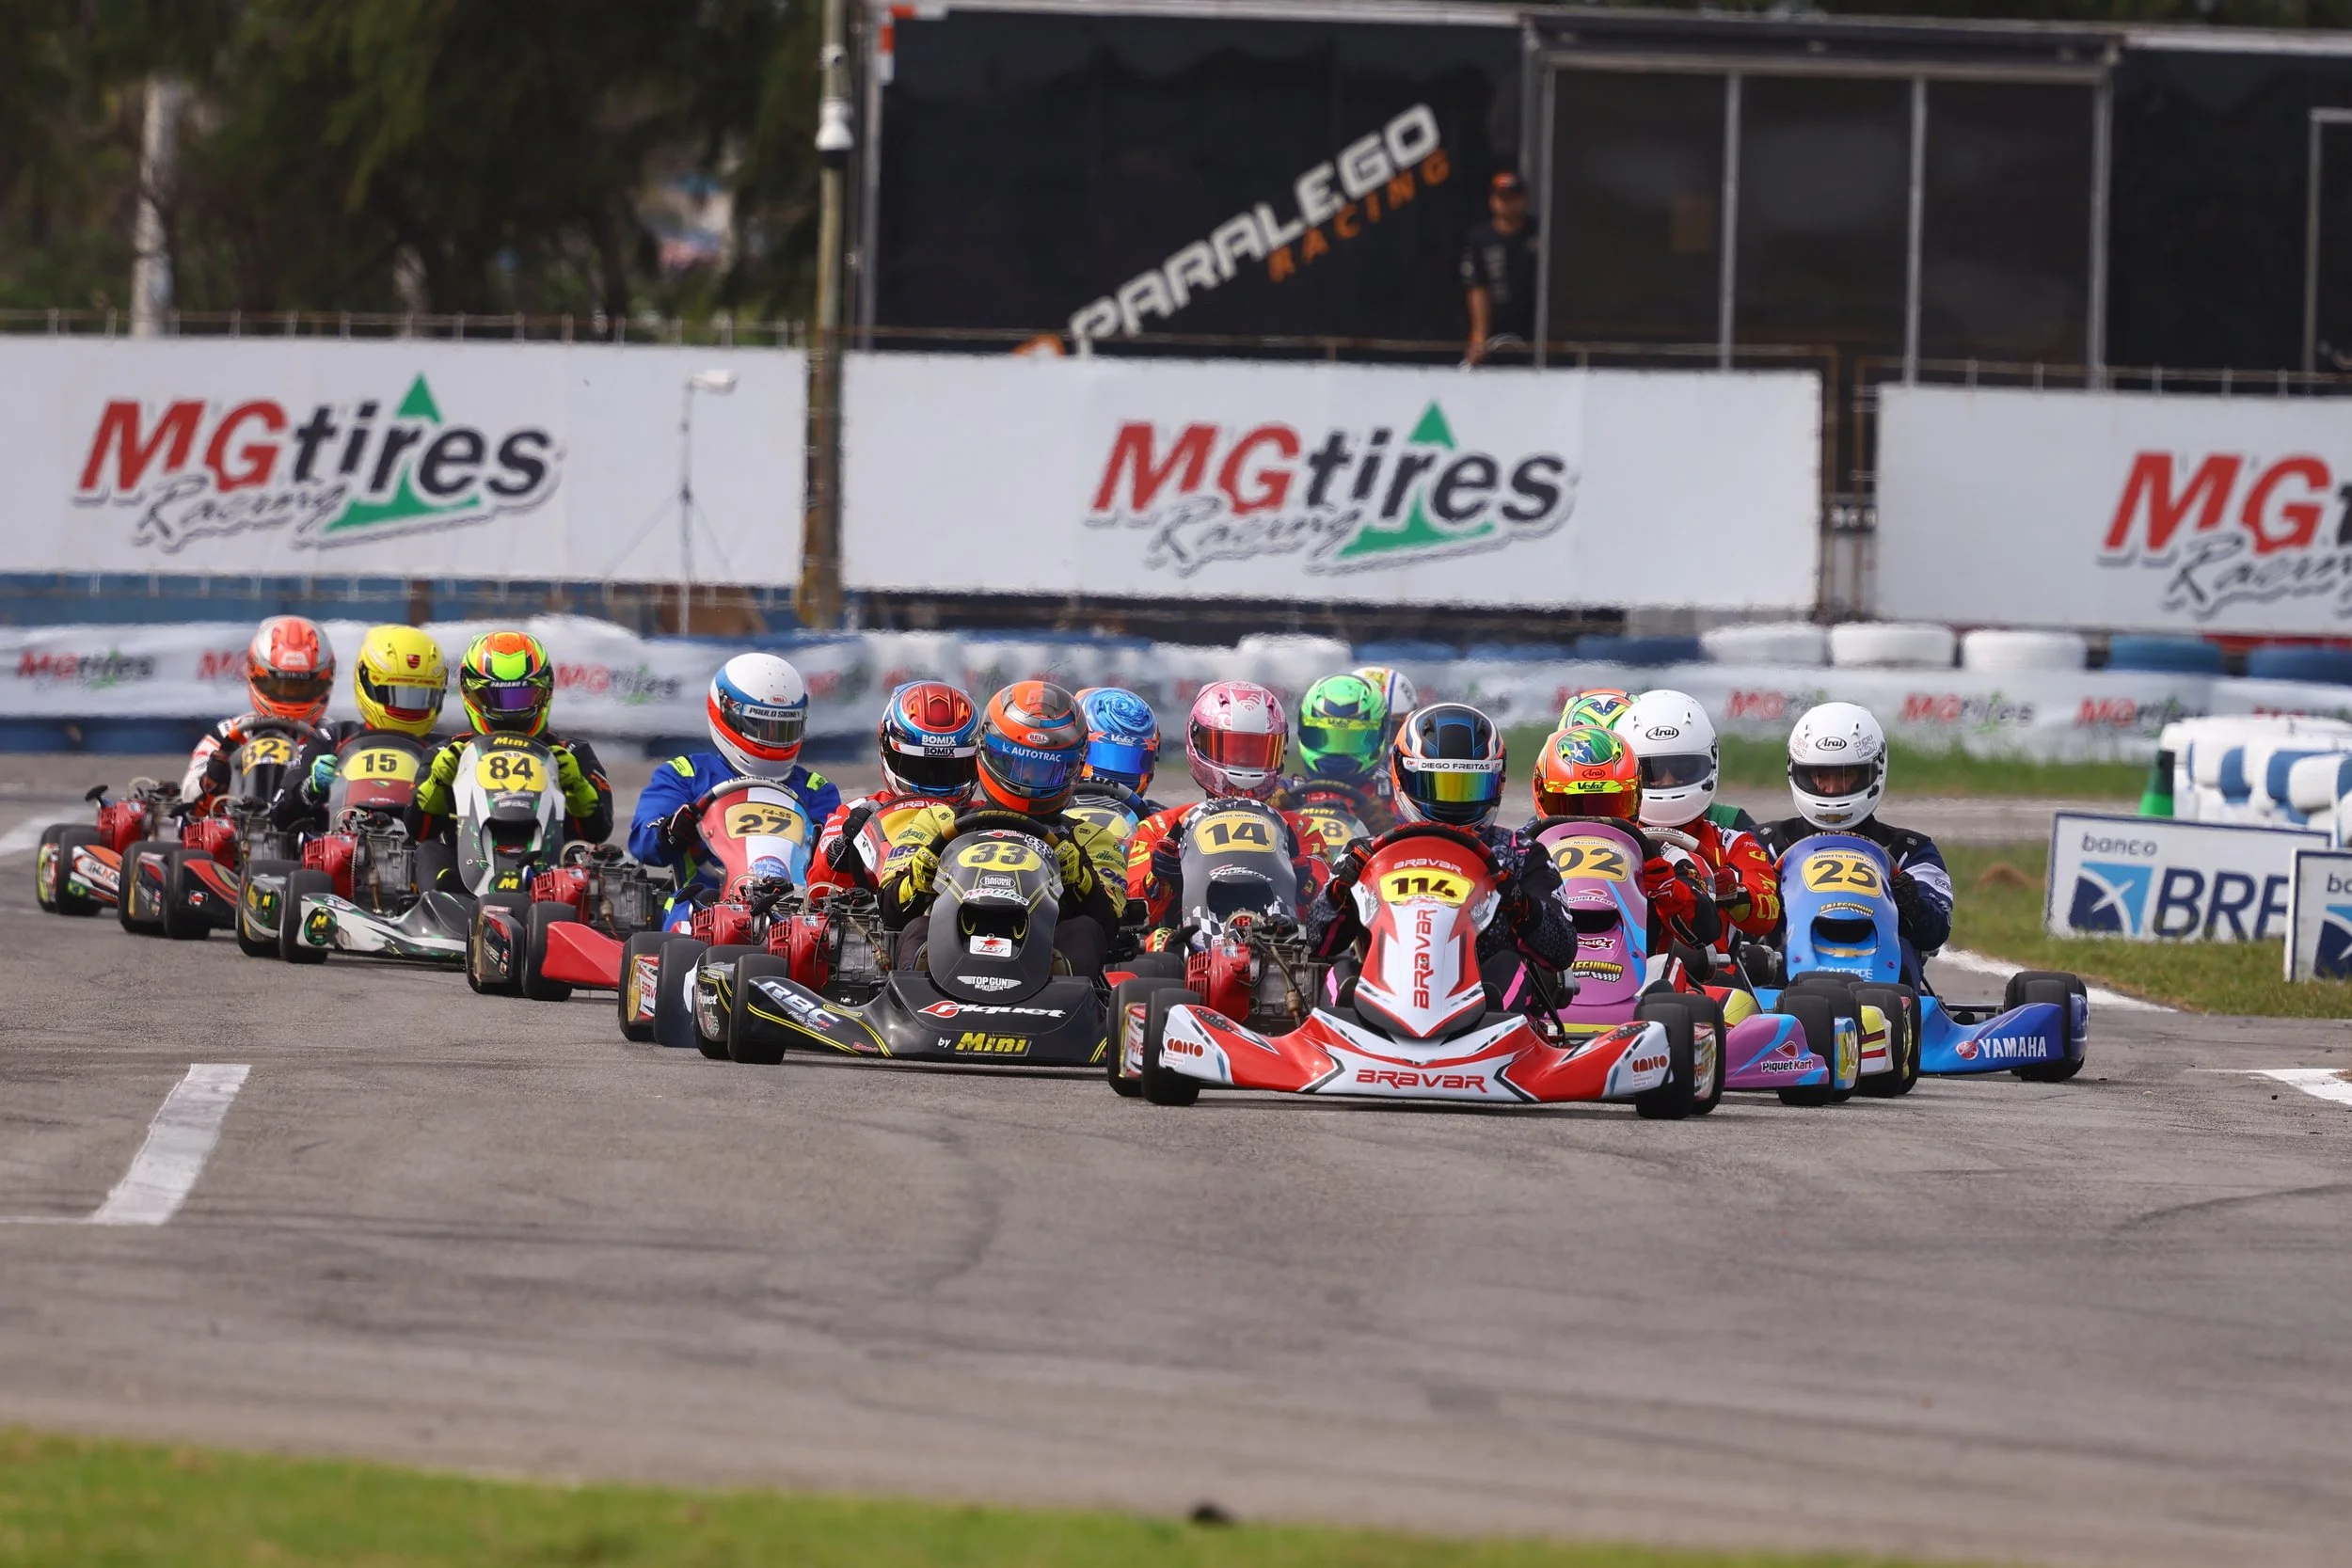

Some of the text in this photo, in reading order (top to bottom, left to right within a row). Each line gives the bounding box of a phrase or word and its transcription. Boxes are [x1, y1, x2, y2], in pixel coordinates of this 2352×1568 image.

[1267, 150, 1451, 282] RACING
[1070, 103, 1440, 357] PARALEGO
[78, 397, 553, 499] MGtires
[1092, 421, 1565, 523] MGtires
[137, 472, 347, 539] Racing
[1149, 495, 1361, 562] Racing
[2167, 531, 2352, 604] Racin
[748, 706, 777, 718] PAULO
[922, 734, 957, 747] BOMIX
[1652, 726, 1676, 737] Arai
[1820, 737, 1843, 748] Arai
[361, 752, 398, 772] 15
[924, 747, 955, 756] BOMIX
[1010, 746, 1062, 763] AUTOTRAC
[489, 756, 533, 782] 84
[1421, 762, 1451, 770] DIEGO
[736, 814, 792, 834] 27
[1205, 822, 1270, 847] 14
[969, 844, 1030, 865] 33
[2081, 832, 2158, 857] banco
[1551, 847, 1625, 879] 02
[1811, 859, 1878, 889] 25
[1391, 877, 1458, 898] 114
[1578, 938, 1607, 947] ocile
[972, 975, 1008, 988] TOP GUN
[758, 980, 841, 1025] RBC
[937, 1003, 1067, 1019] Piquet
[937, 1031, 1031, 1054] by Mini
[1979, 1036, 2047, 1058] YAMAHA
